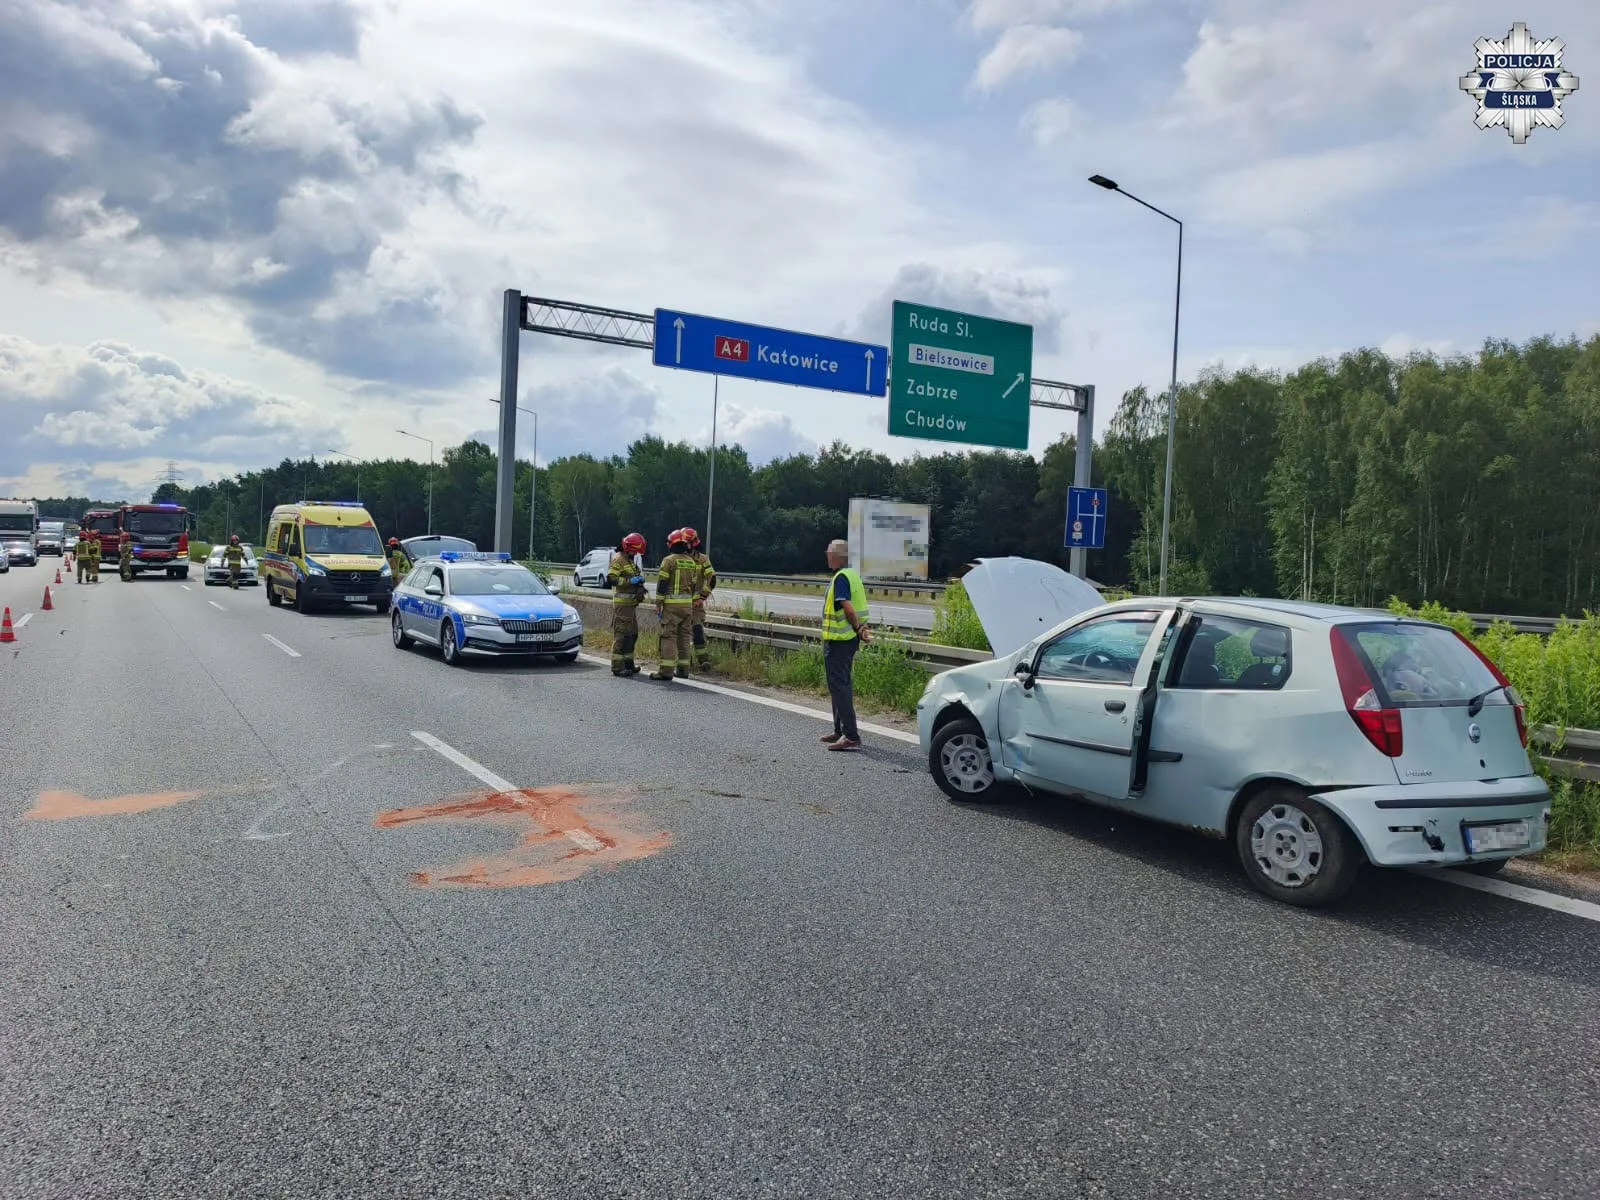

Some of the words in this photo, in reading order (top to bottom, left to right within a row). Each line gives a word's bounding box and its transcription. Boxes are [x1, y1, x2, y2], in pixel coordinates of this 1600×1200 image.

[909, 312, 948, 334] Ruda
[721, 340, 742, 357] A4
[757, 344, 838, 373] Katowice
[916, 348, 987, 371] Bielszowice
[906, 378, 958, 400] Zabrze
[905, 409, 967, 432] Chudów
